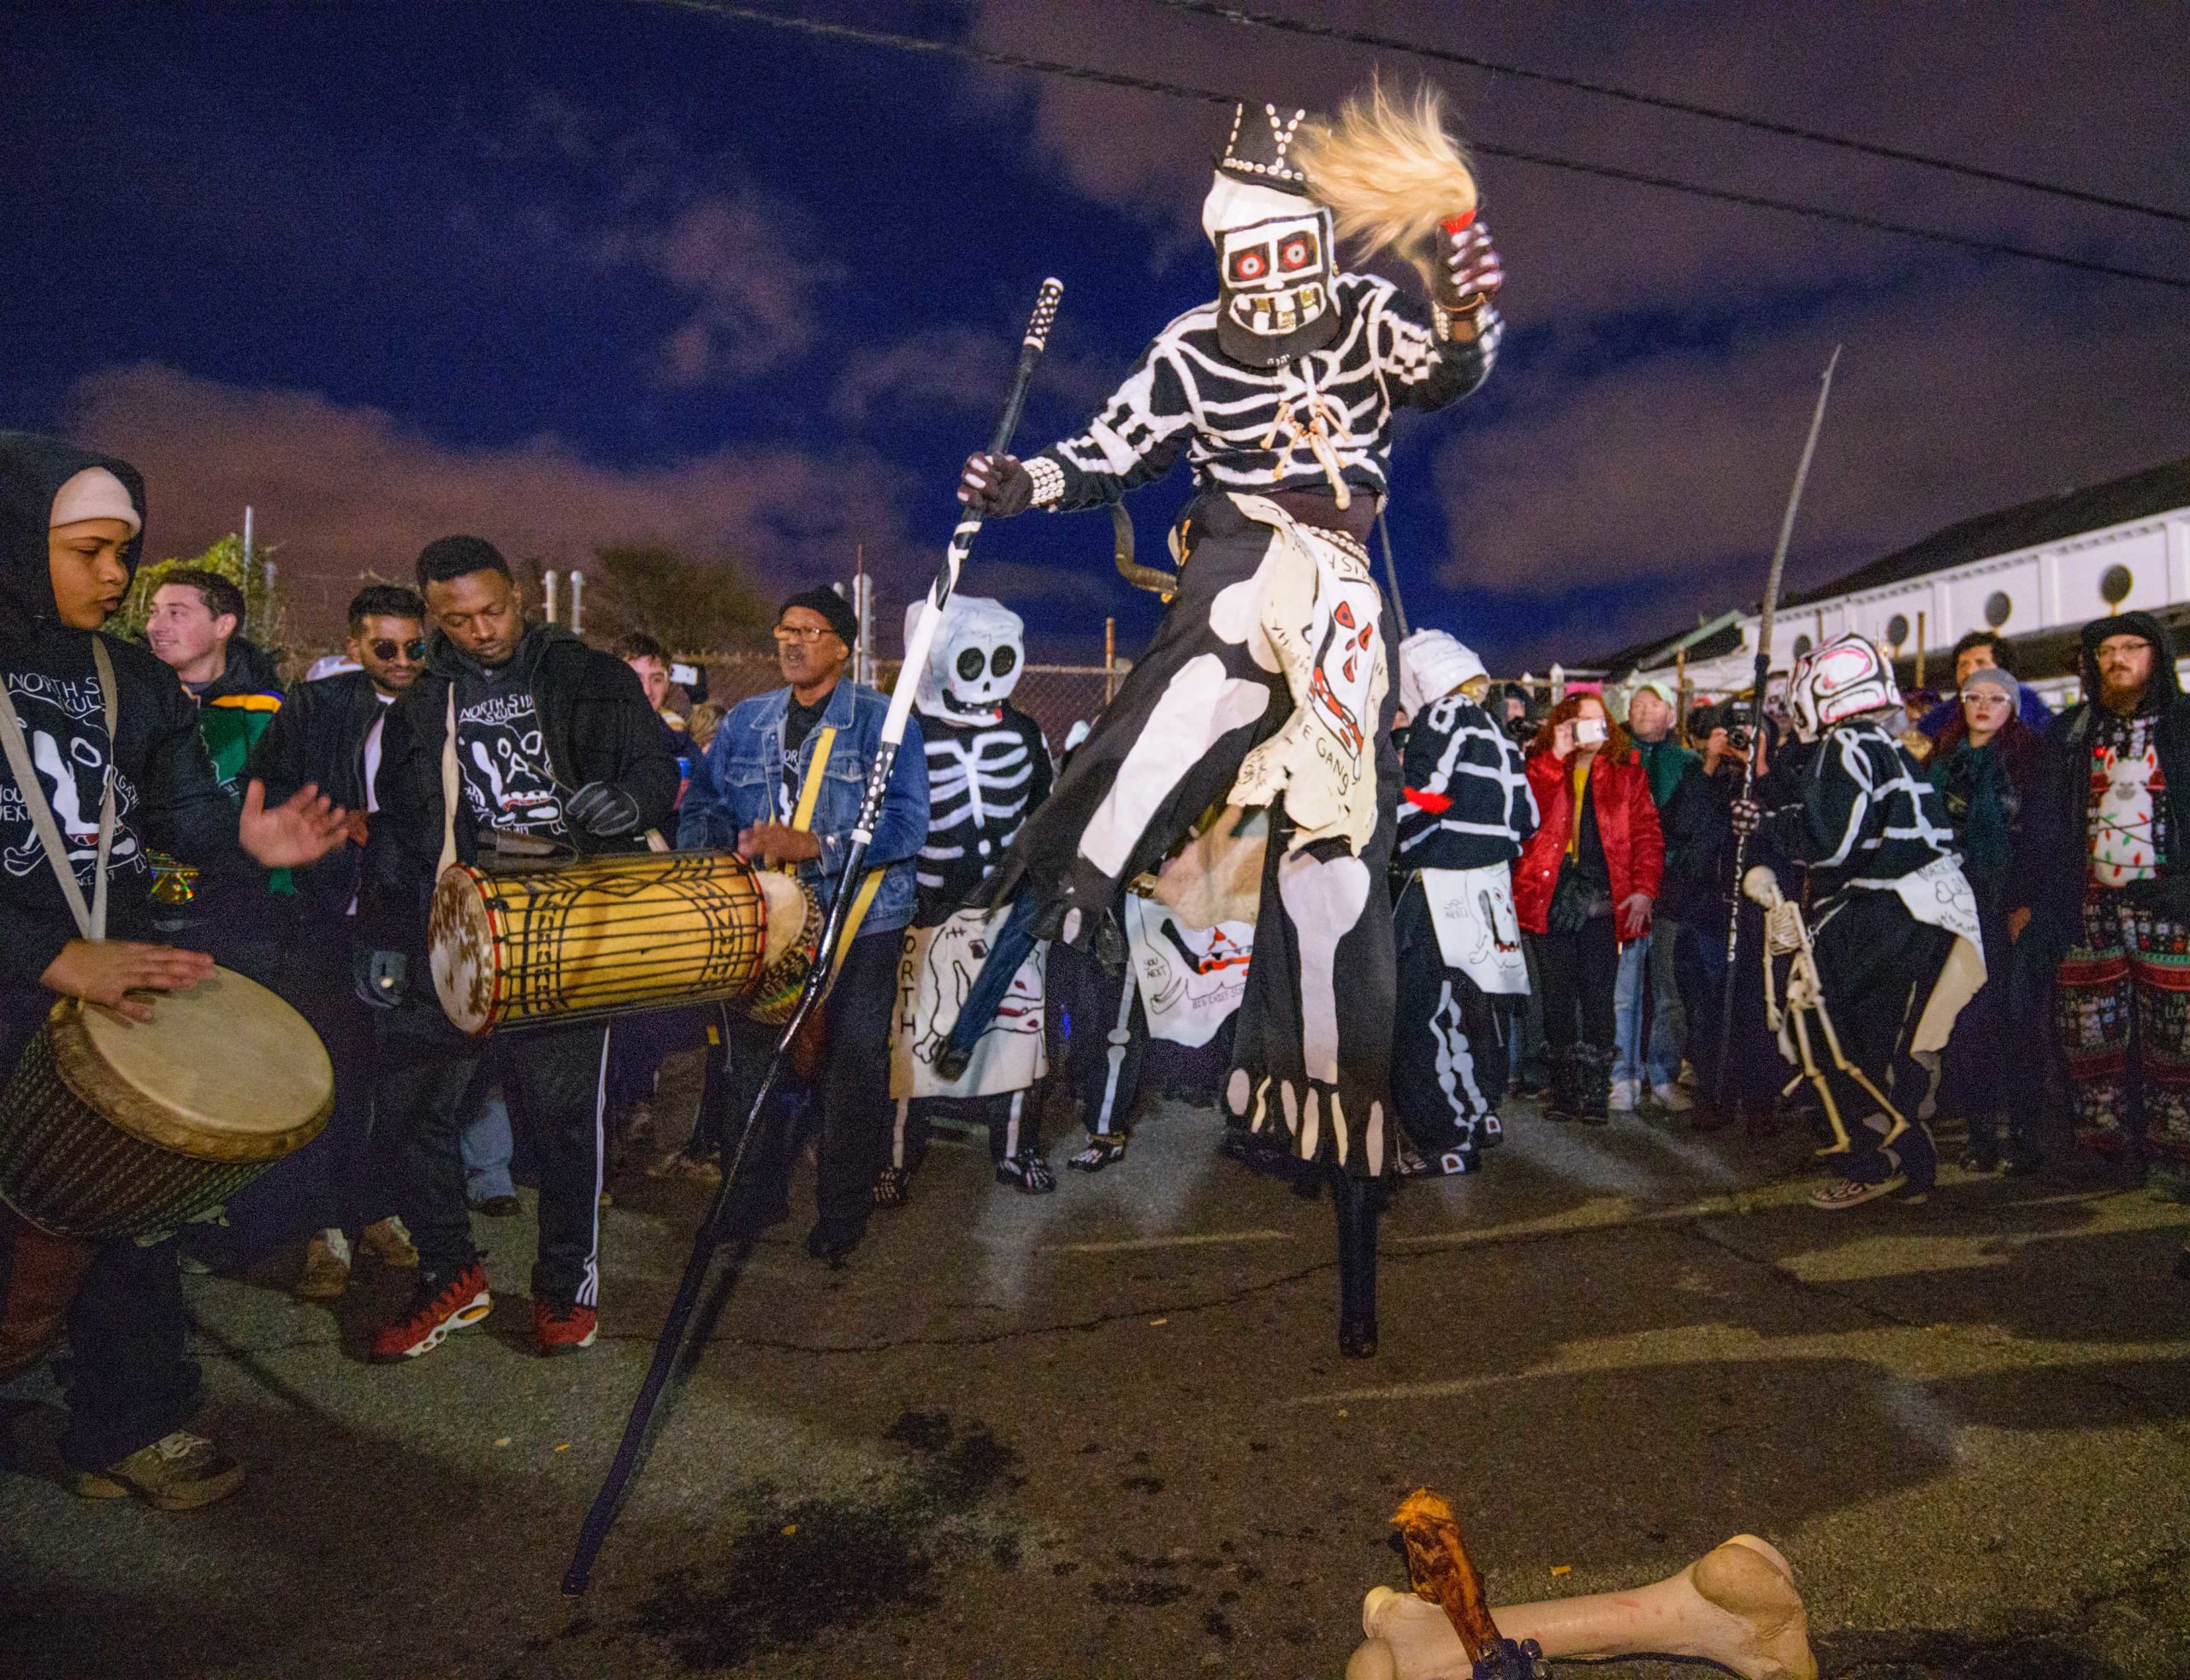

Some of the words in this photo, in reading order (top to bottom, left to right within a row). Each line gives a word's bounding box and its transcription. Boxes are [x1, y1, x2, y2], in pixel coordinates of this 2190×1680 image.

[8, 671, 80, 699] NORTH
[459, 697, 505, 720] NORTH
[506, 693, 535, 709] SID
[484, 703, 518, 723] SKULL
[0, 784, 26, 804] OU
